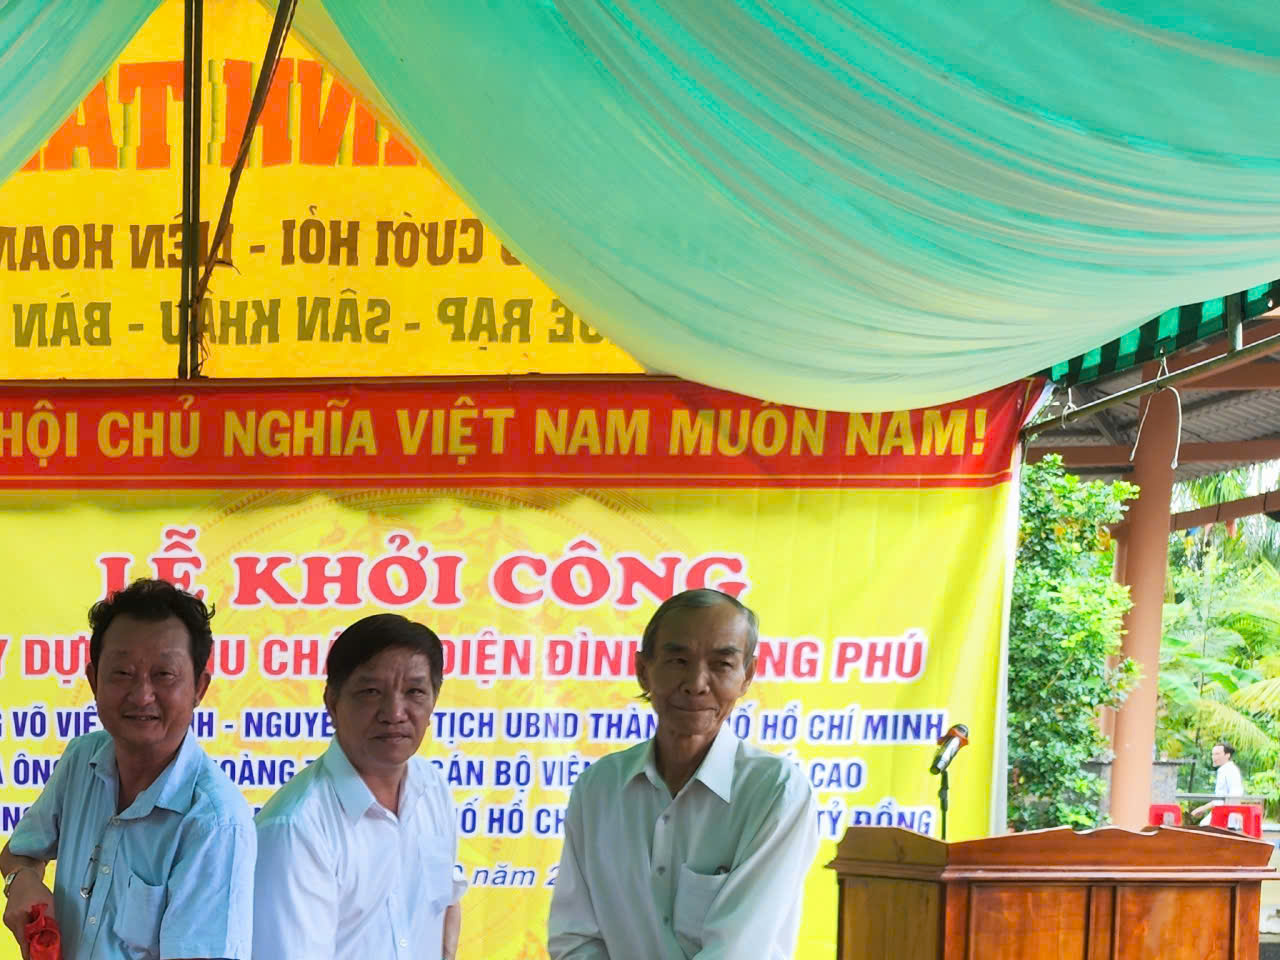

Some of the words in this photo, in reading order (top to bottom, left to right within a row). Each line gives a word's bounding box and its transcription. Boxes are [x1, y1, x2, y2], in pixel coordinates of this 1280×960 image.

[97, 394, 200, 458] CHỦ
[223, 400, 377, 457] NGHĨA
[396, 396, 515, 465] VIỆT
[535, 408, 650, 457] NAM
[233, 534, 463, 605] KHỞI
[493, 540, 747, 606] CÔNG
[835, 633, 925, 678] PHÚ
[13, 705, 47, 737] VÕ
[433, 712, 494, 744] TỊCH
[506, 712, 578, 738] UBND
[761, 704, 799, 740] HỒ
[809, 708, 856, 740] CHÍ
[862, 713, 944, 740] MINH
[218, 753, 295, 785] OÀNG
[495, 755, 531, 792] BỘ
[811, 762, 863, 789] CAO
[487, 799, 524, 834] HỒ
[472, 866, 536, 886] năm
